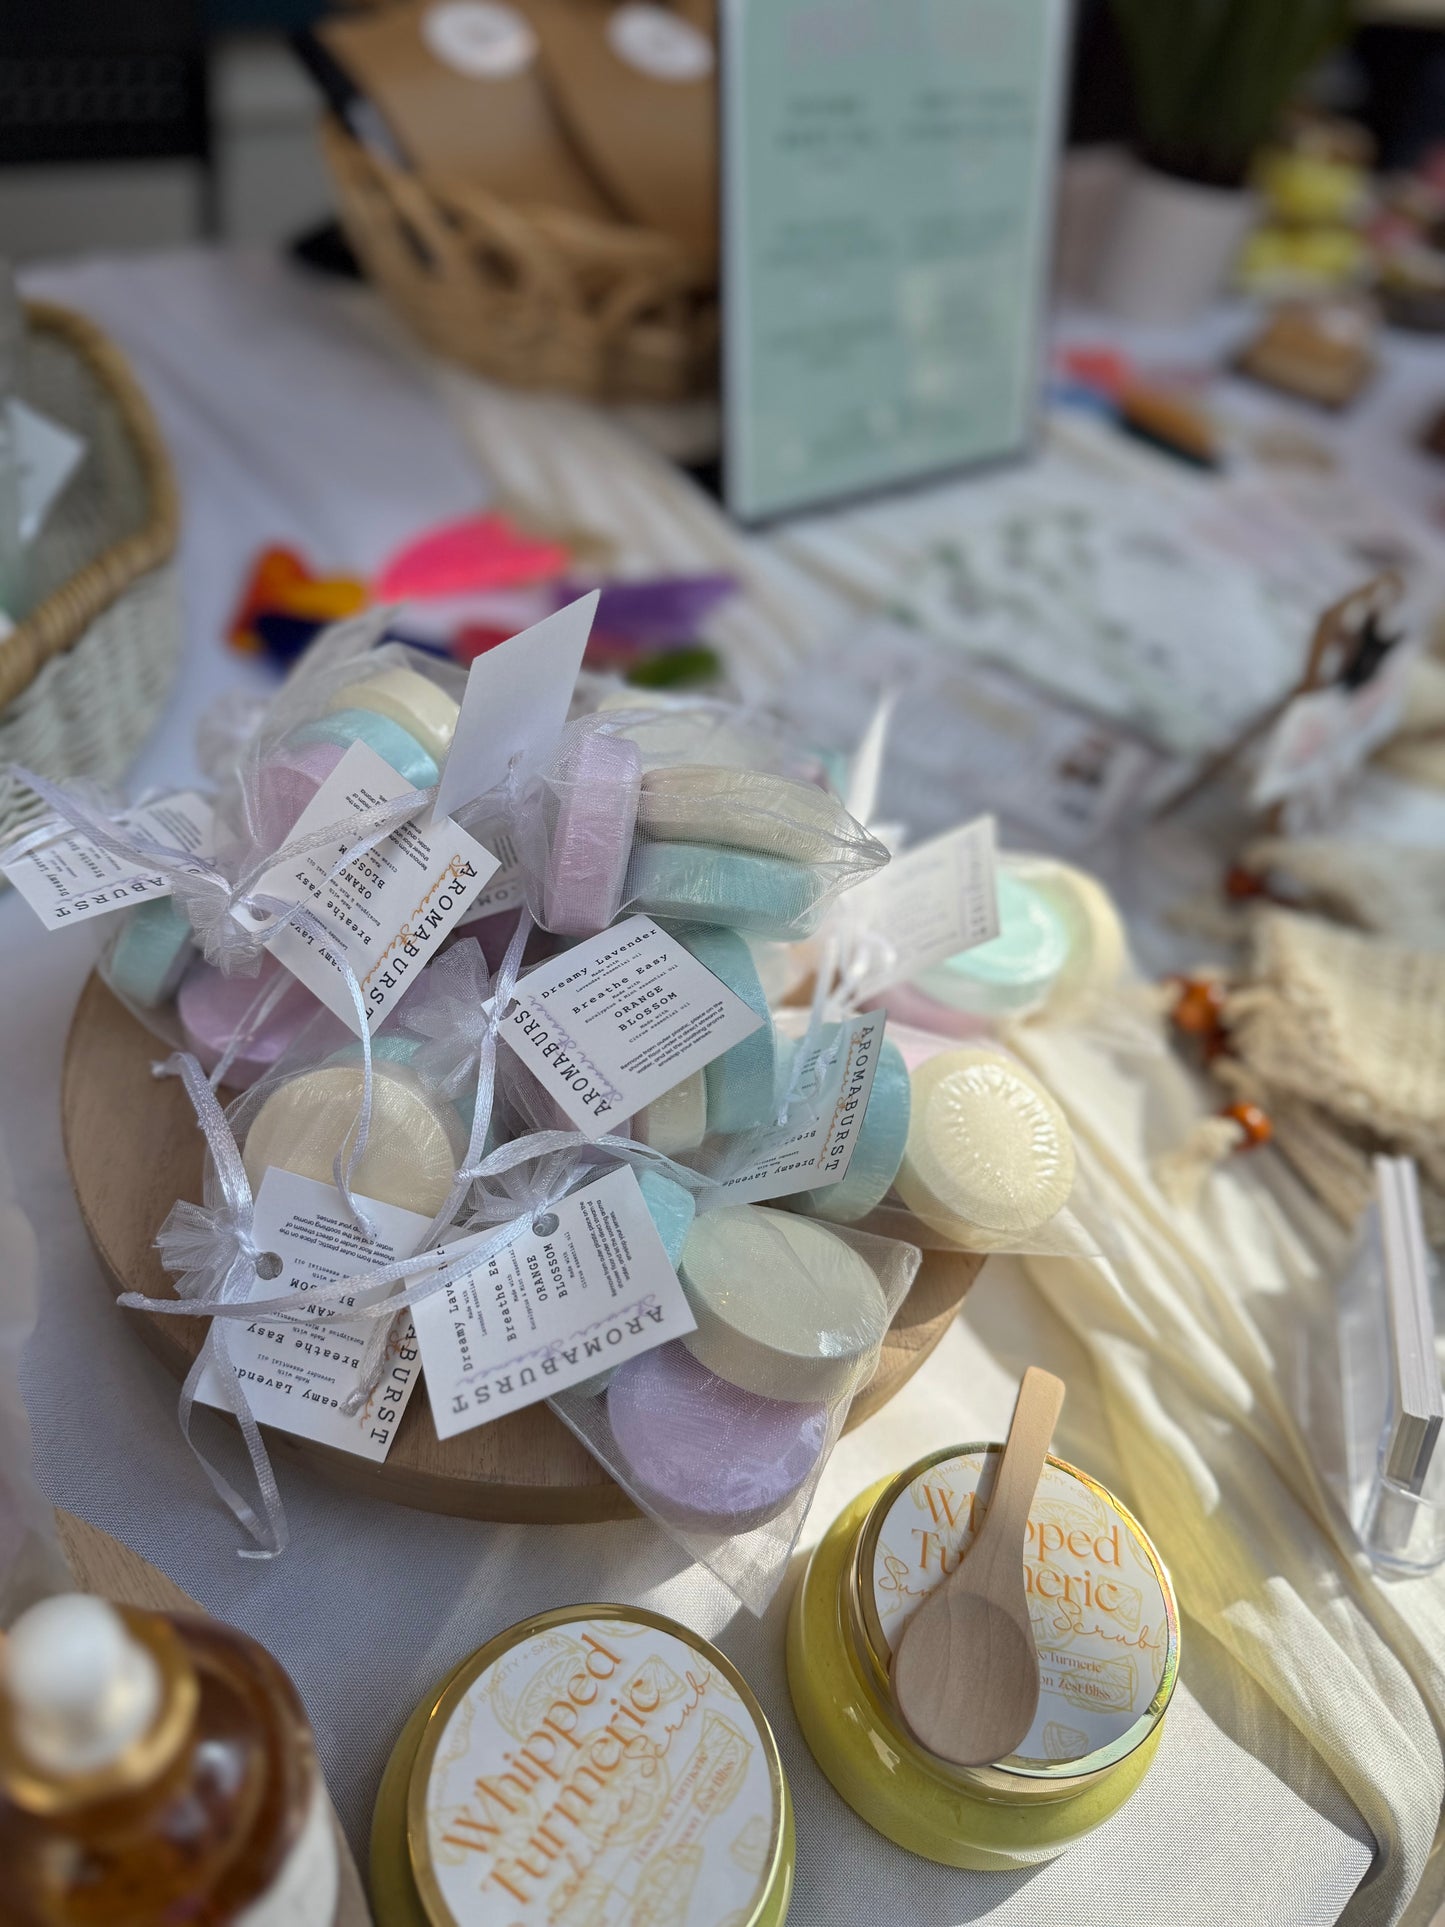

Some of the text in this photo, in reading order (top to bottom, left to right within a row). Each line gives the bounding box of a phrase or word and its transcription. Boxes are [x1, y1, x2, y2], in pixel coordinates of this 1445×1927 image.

[337, 843, 385, 889] BLOSSM
[294, 871, 322, 899] Easy
[328, 886, 340, 899] with
[331, 860, 372, 900] ORANG
[326, 899, 371, 945] Breathe
[358, 925, 422, 1000] Steame
[540, 928, 657, 999] Dreamy Lavender
[571, 953, 667, 1014] Breathe Easy
[613, 984, 663, 1018] ORANGE
[617, 991, 677, 1031] BLOSSOM
[823, 1025, 874, 1171] AROMABURST
[773, 1157, 815, 1174] Dreamy
[721, 1170, 768, 1187] Lavende
[278, 1227, 290, 1235] the
[292, 1214, 315, 1226] aroma
[292, 1223, 315, 1235] stream
[313, 1220, 341, 1235] soothing
[337, 1221, 352, 1230] your
[289, 1230, 299, 1238] on
[298, 1233, 317, 1244] place
[314, 1230, 334, 1241] direct
[338, 1239, 358, 1249] under
[340, 1230, 353, 1239] the
[338, 1247, 356, 1257] outer
[355, 1252, 372, 1262] from
[357, 1245, 373, 1255] floor
[372, 1250, 395, 1261] shower
[525, 1254, 548, 1302] ORANGE
[542, 1242, 568, 1298] BLOSSOM
[494, 1283, 517, 1342] Breathe
[246, 1322, 360, 1369] Breathe Easy
[292, 1325, 325, 1341] Made with
[452, 1304, 664, 1413] AROMABURST
[453, 1321, 473, 1371] Dreamy
[270, 1357, 304, 1372] essential
[276, 1368, 310, 1384] Made with
[232, 1365, 293, 1394] Lavend
[923, 1483, 1120, 1567] Whped
[1052, 1600, 1160, 1650] Scrub
[1046, 1650, 1103, 1673] Turmeric
[1056, 1676, 1083, 1693] Zest
[1083, 1682, 1111, 1699] Bliss
[623, 1670, 711, 1779] Scrub
[441, 1633, 623, 1851] Whipped
[481, 1677, 660, 1905] Turmeric
